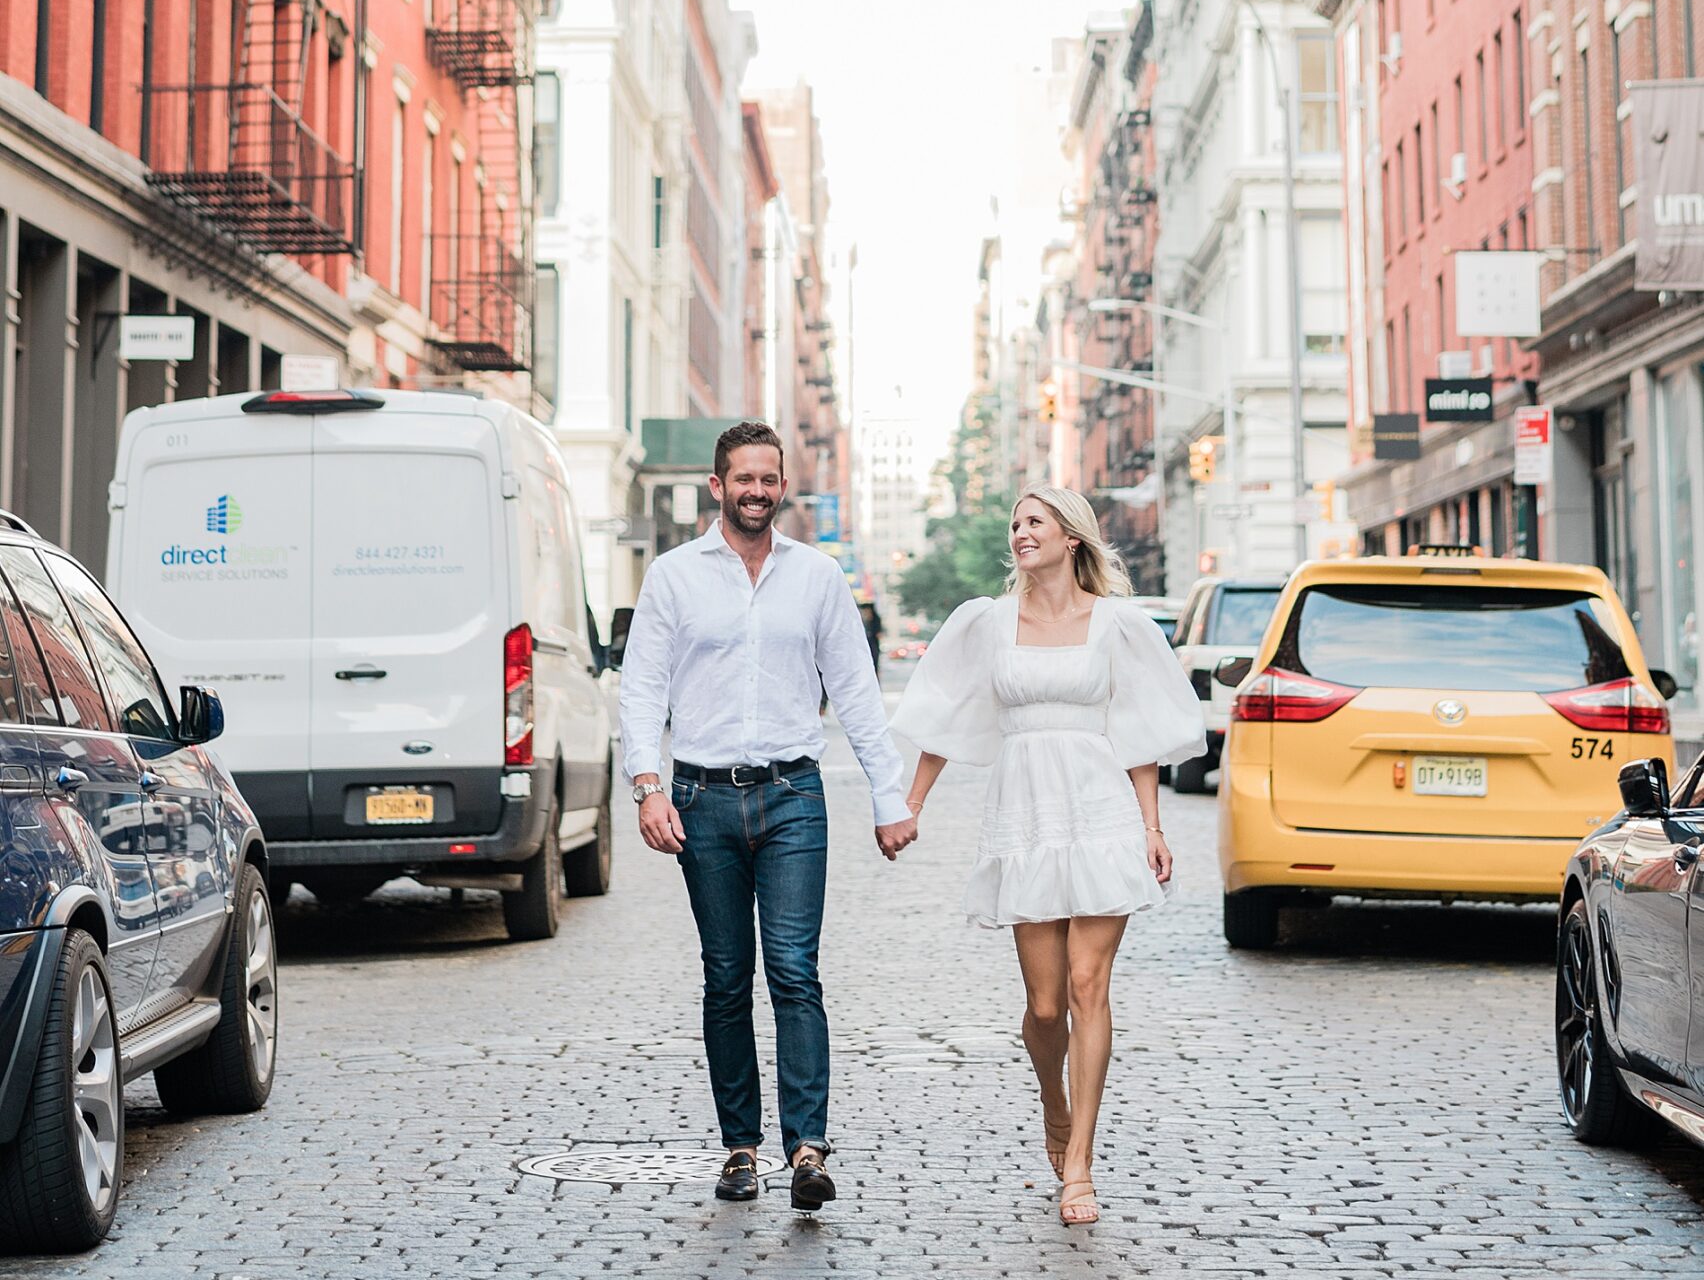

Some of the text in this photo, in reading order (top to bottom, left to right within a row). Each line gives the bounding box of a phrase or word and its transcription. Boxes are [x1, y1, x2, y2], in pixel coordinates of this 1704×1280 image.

[1654, 193, 1704, 227] um
[161, 568, 290, 583] SERVICE SOLUTIONS
[1571, 737, 1614, 760] 574
